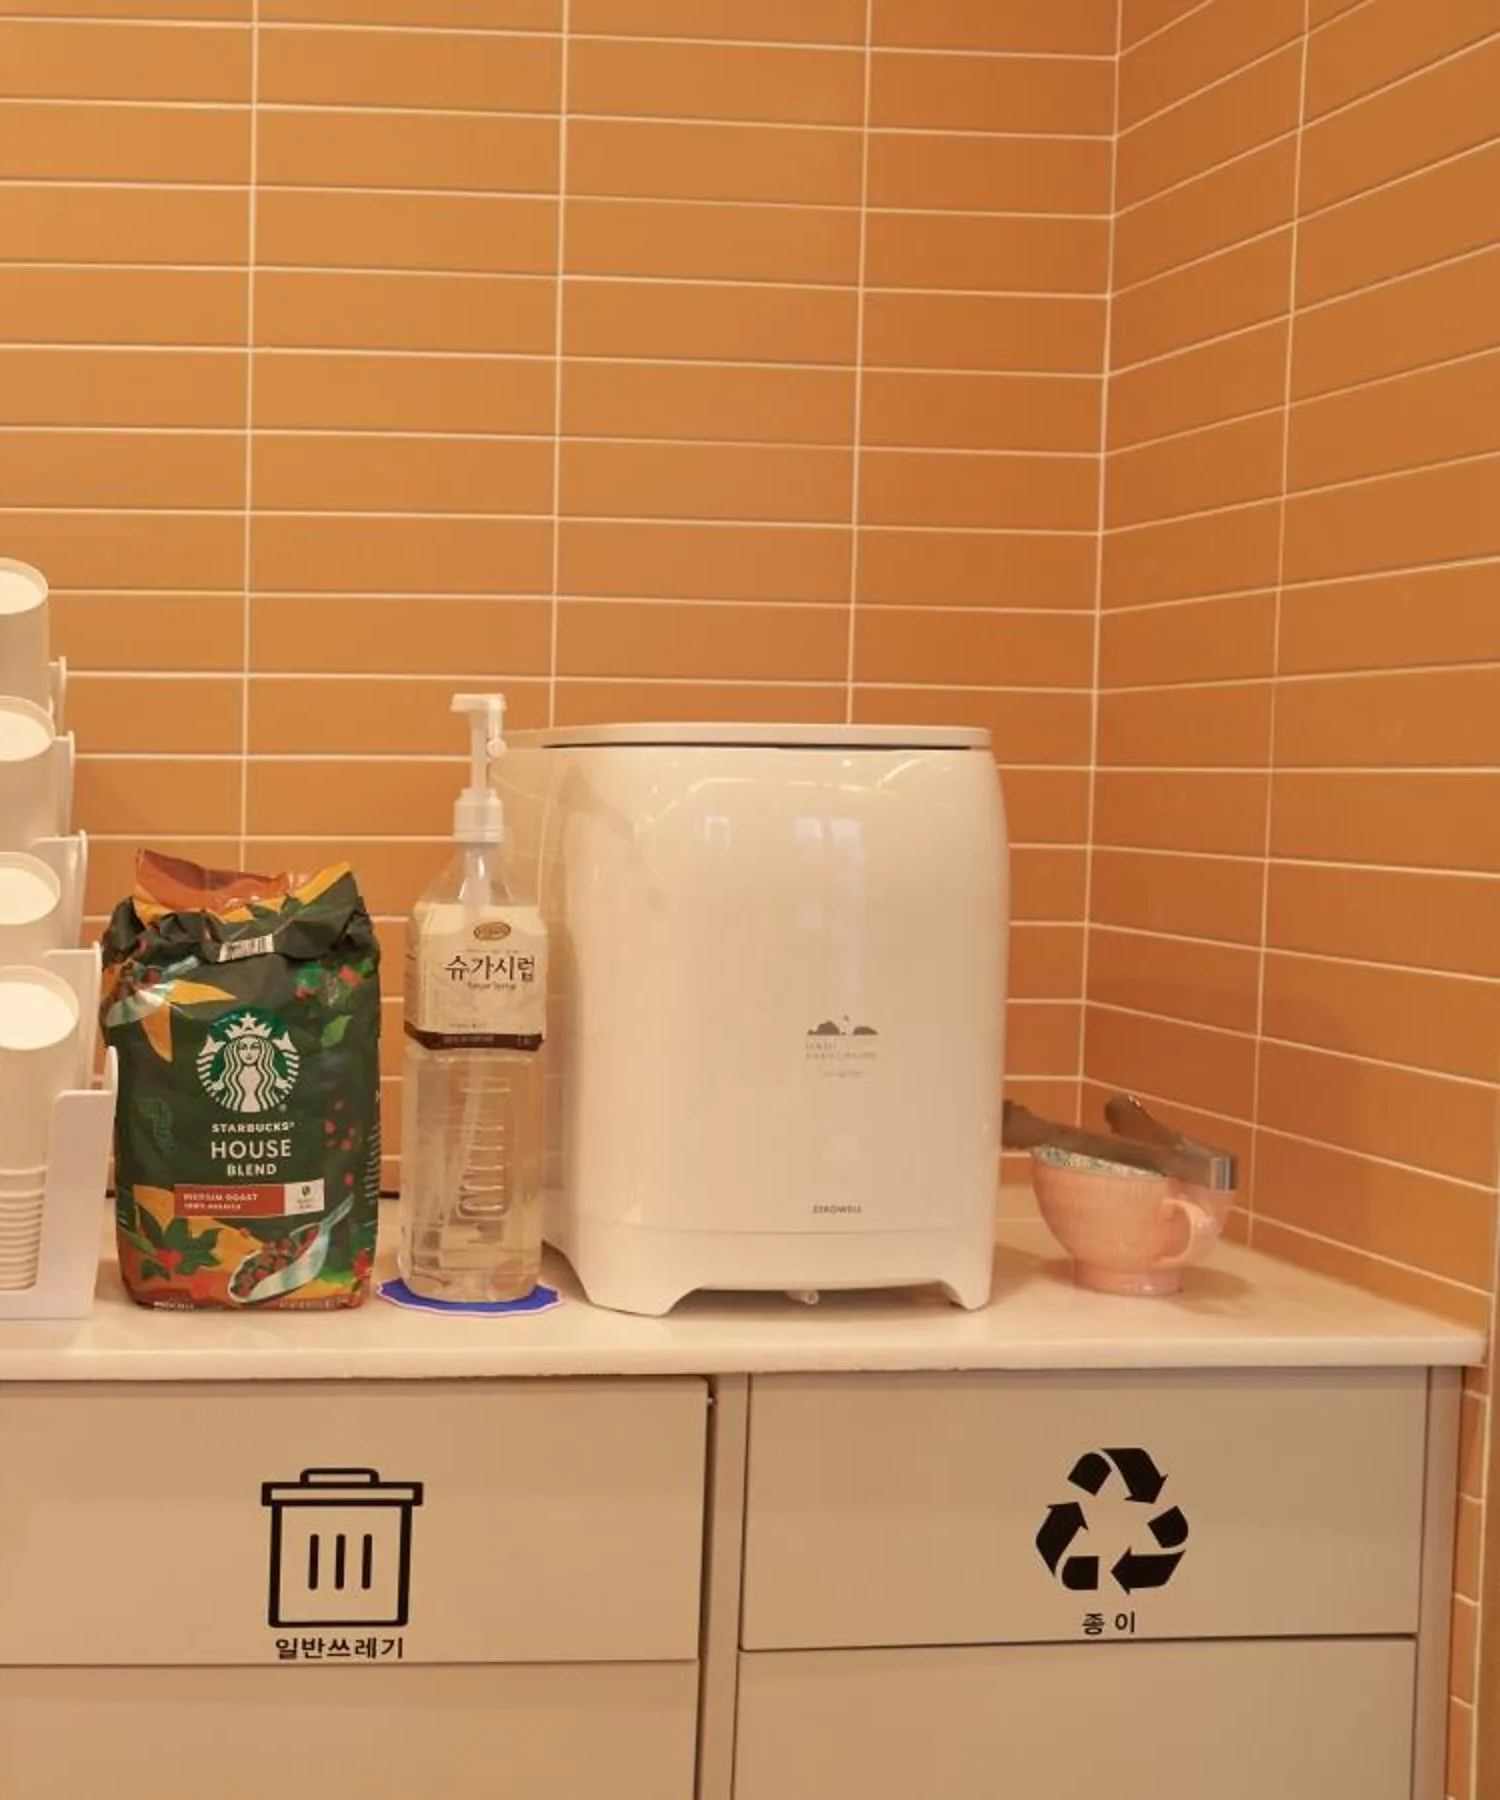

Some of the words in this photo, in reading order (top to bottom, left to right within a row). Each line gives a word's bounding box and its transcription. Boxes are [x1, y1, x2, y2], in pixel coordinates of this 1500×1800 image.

[445, 955, 535, 982] 슈가시럽
[211, 1121, 289, 1133] STARBUCKS
[211, 1139, 292, 1159] HOUSE
[227, 1163, 277, 1176] BLEND
[275, 1637, 404, 1660] 일반쓰레기
